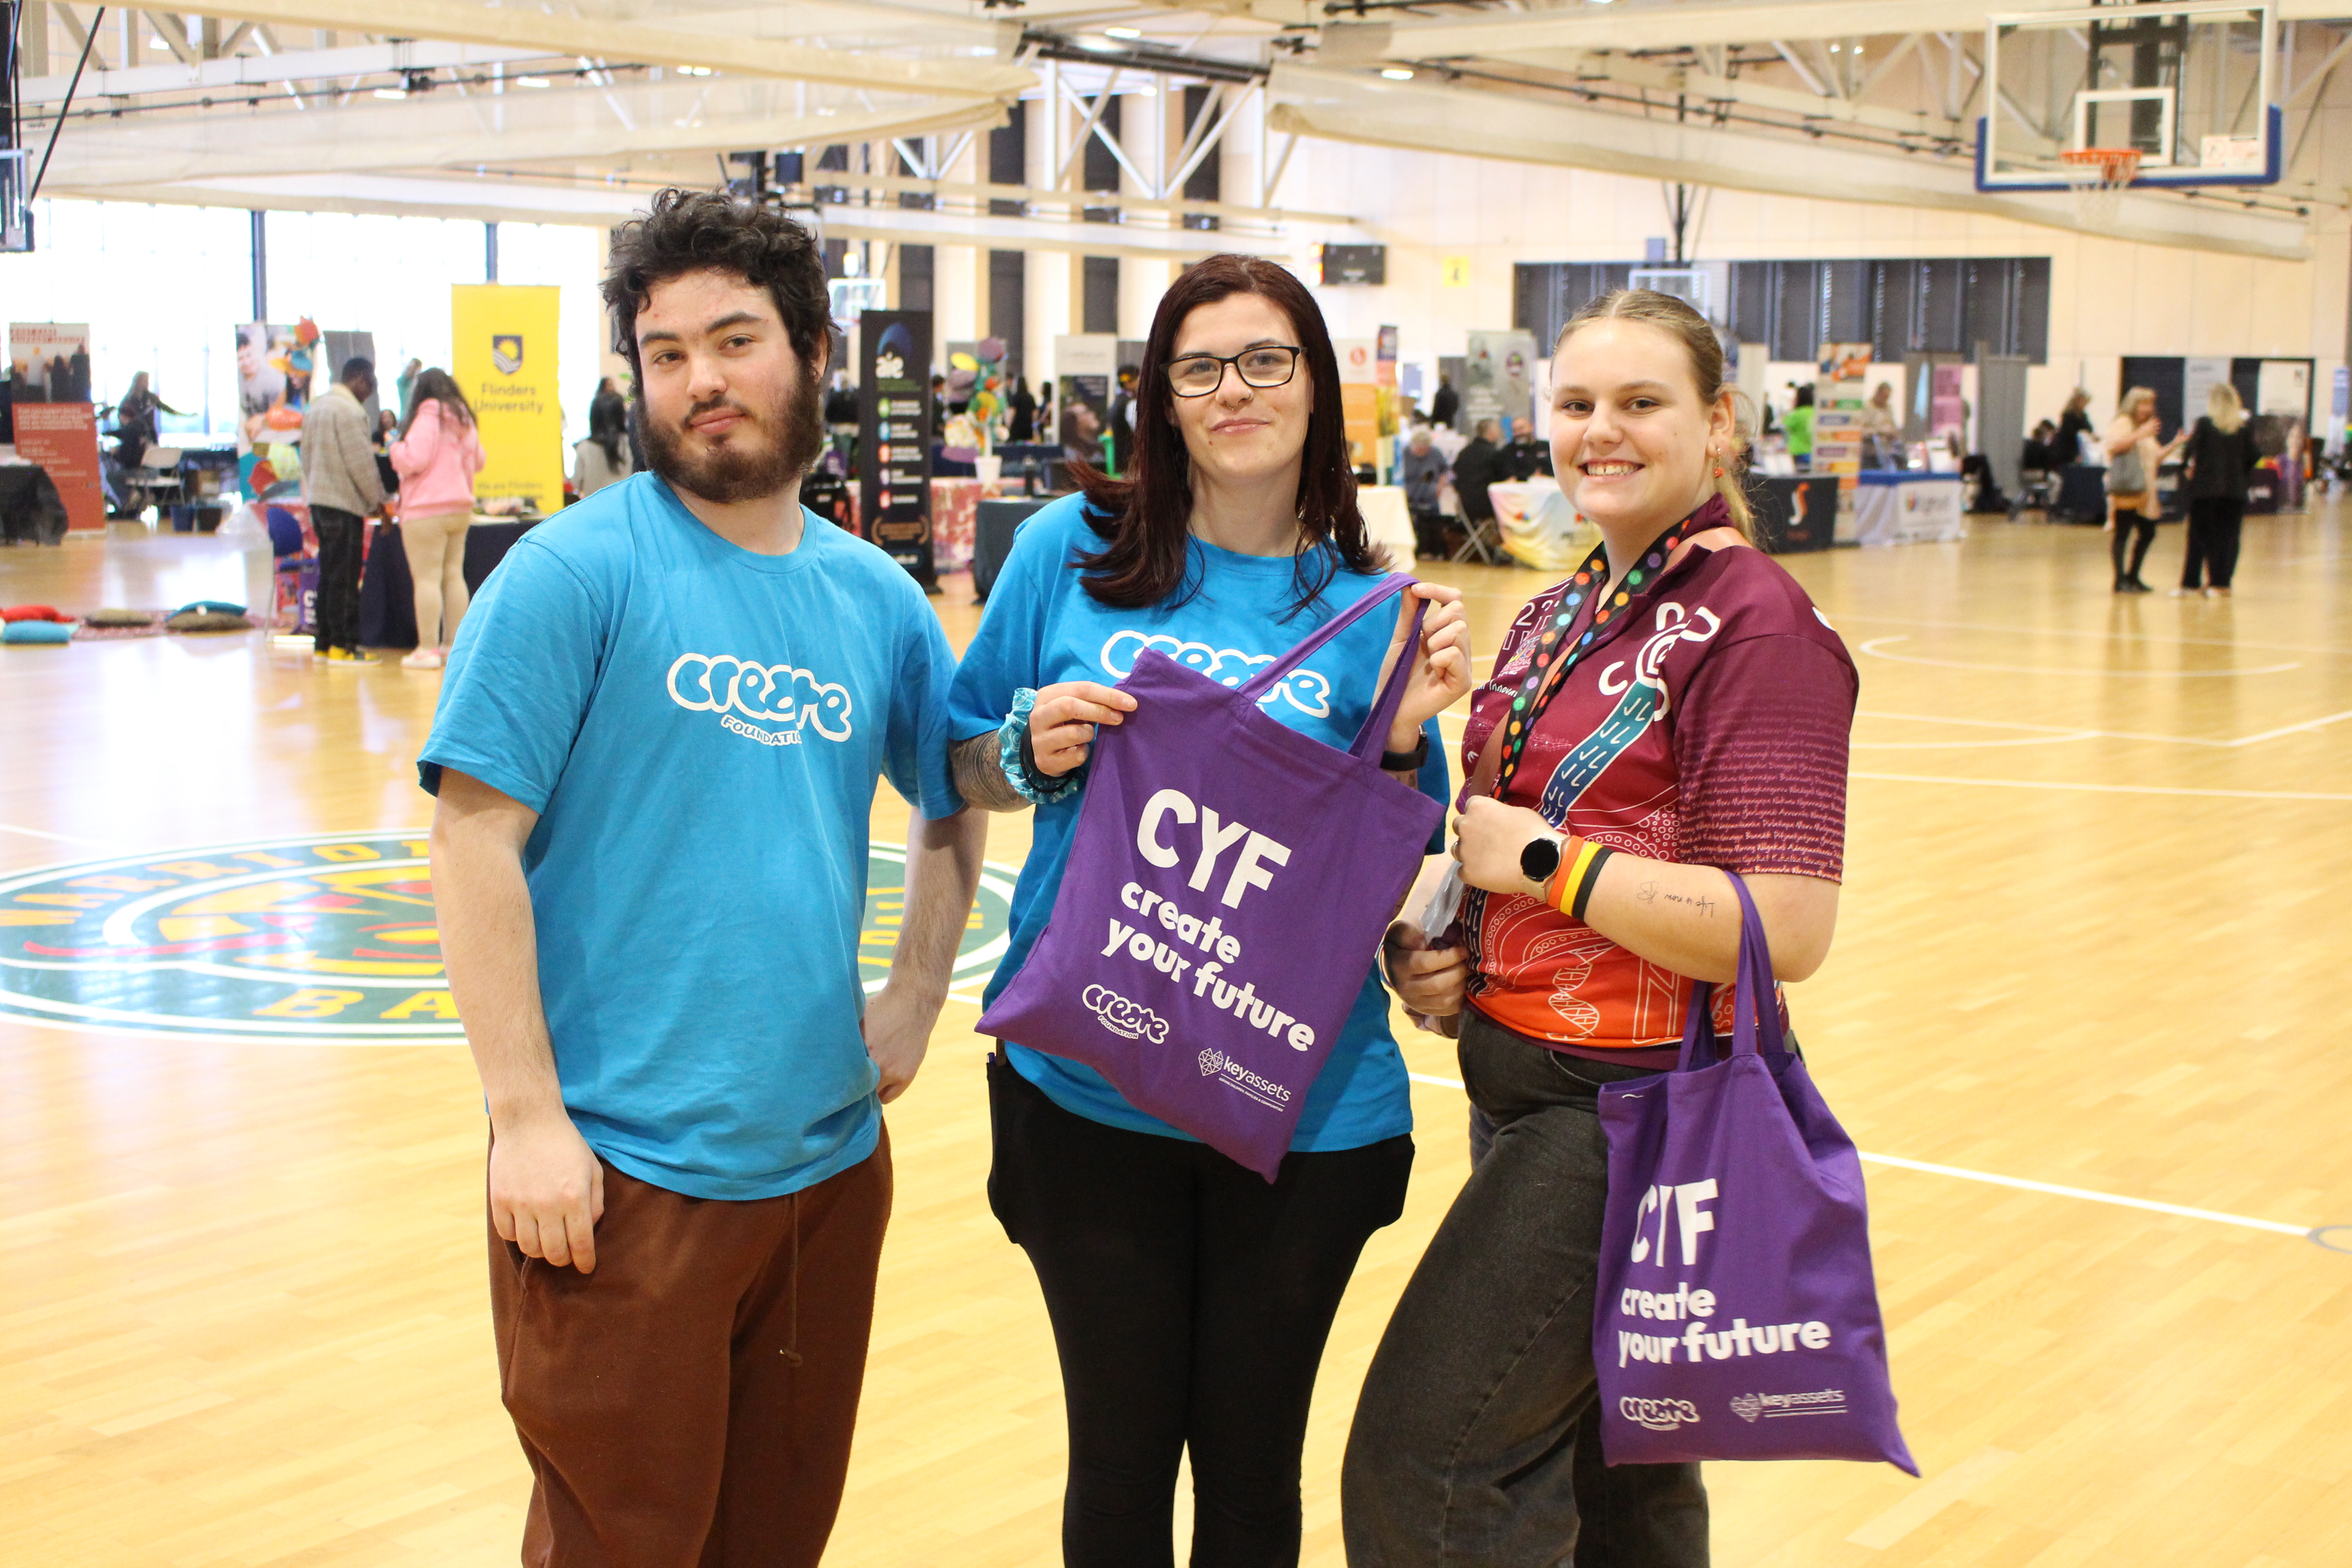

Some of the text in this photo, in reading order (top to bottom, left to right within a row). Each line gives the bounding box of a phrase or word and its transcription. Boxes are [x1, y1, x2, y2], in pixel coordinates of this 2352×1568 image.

[876, 351, 904, 379] aie
[474, 398, 544, 414] University
[481, 382, 536, 396] Flinders
[720, 714, 803, 746] FOUNDATI
[1137, 789, 1292, 909] CYF
[1120, 881, 1242, 965] create
[1100, 917, 1316, 1052] your future
[1081, 984, 1169, 1044] create
[1097, 1015, 1139, 1040] FOUNDATION
[1218, 1077, 1231, 1086] SERVING
[1245, 1091, 1259, 1101] FAMILIES
[1260, 1099, 1284, 1112] COMMUNITIES
[1224, 1055, 1291, 1102] keyassets
[1621, 1282, 1716, 1321] create
[1618, 1318, 1832, 1368] your future
[1759, 1388, 1846, 1408] keyassets
